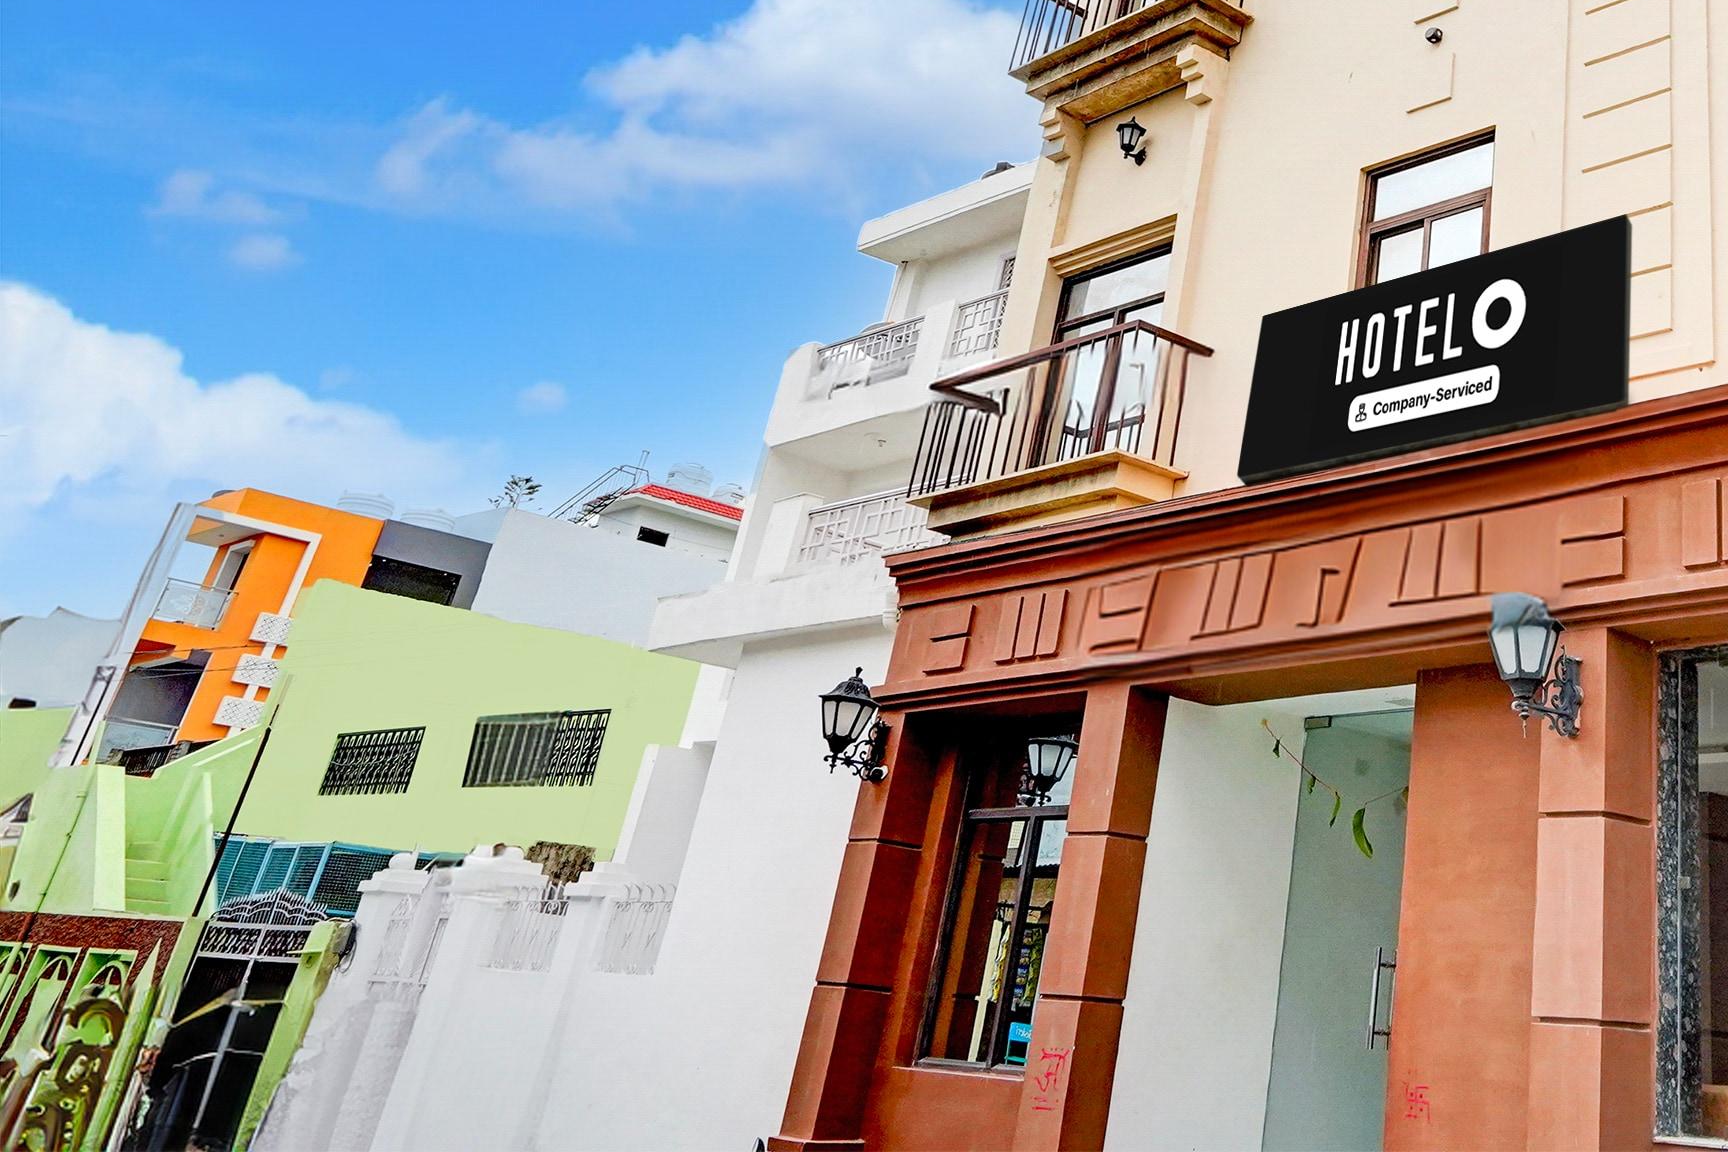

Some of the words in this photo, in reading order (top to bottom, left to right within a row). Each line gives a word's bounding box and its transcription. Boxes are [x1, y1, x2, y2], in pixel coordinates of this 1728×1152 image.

[1334, 292, 1463, 386] HOTEL
[1471, 278, 1527, 349] O
[1372, 376, 1493, 416] Company-Serviced
